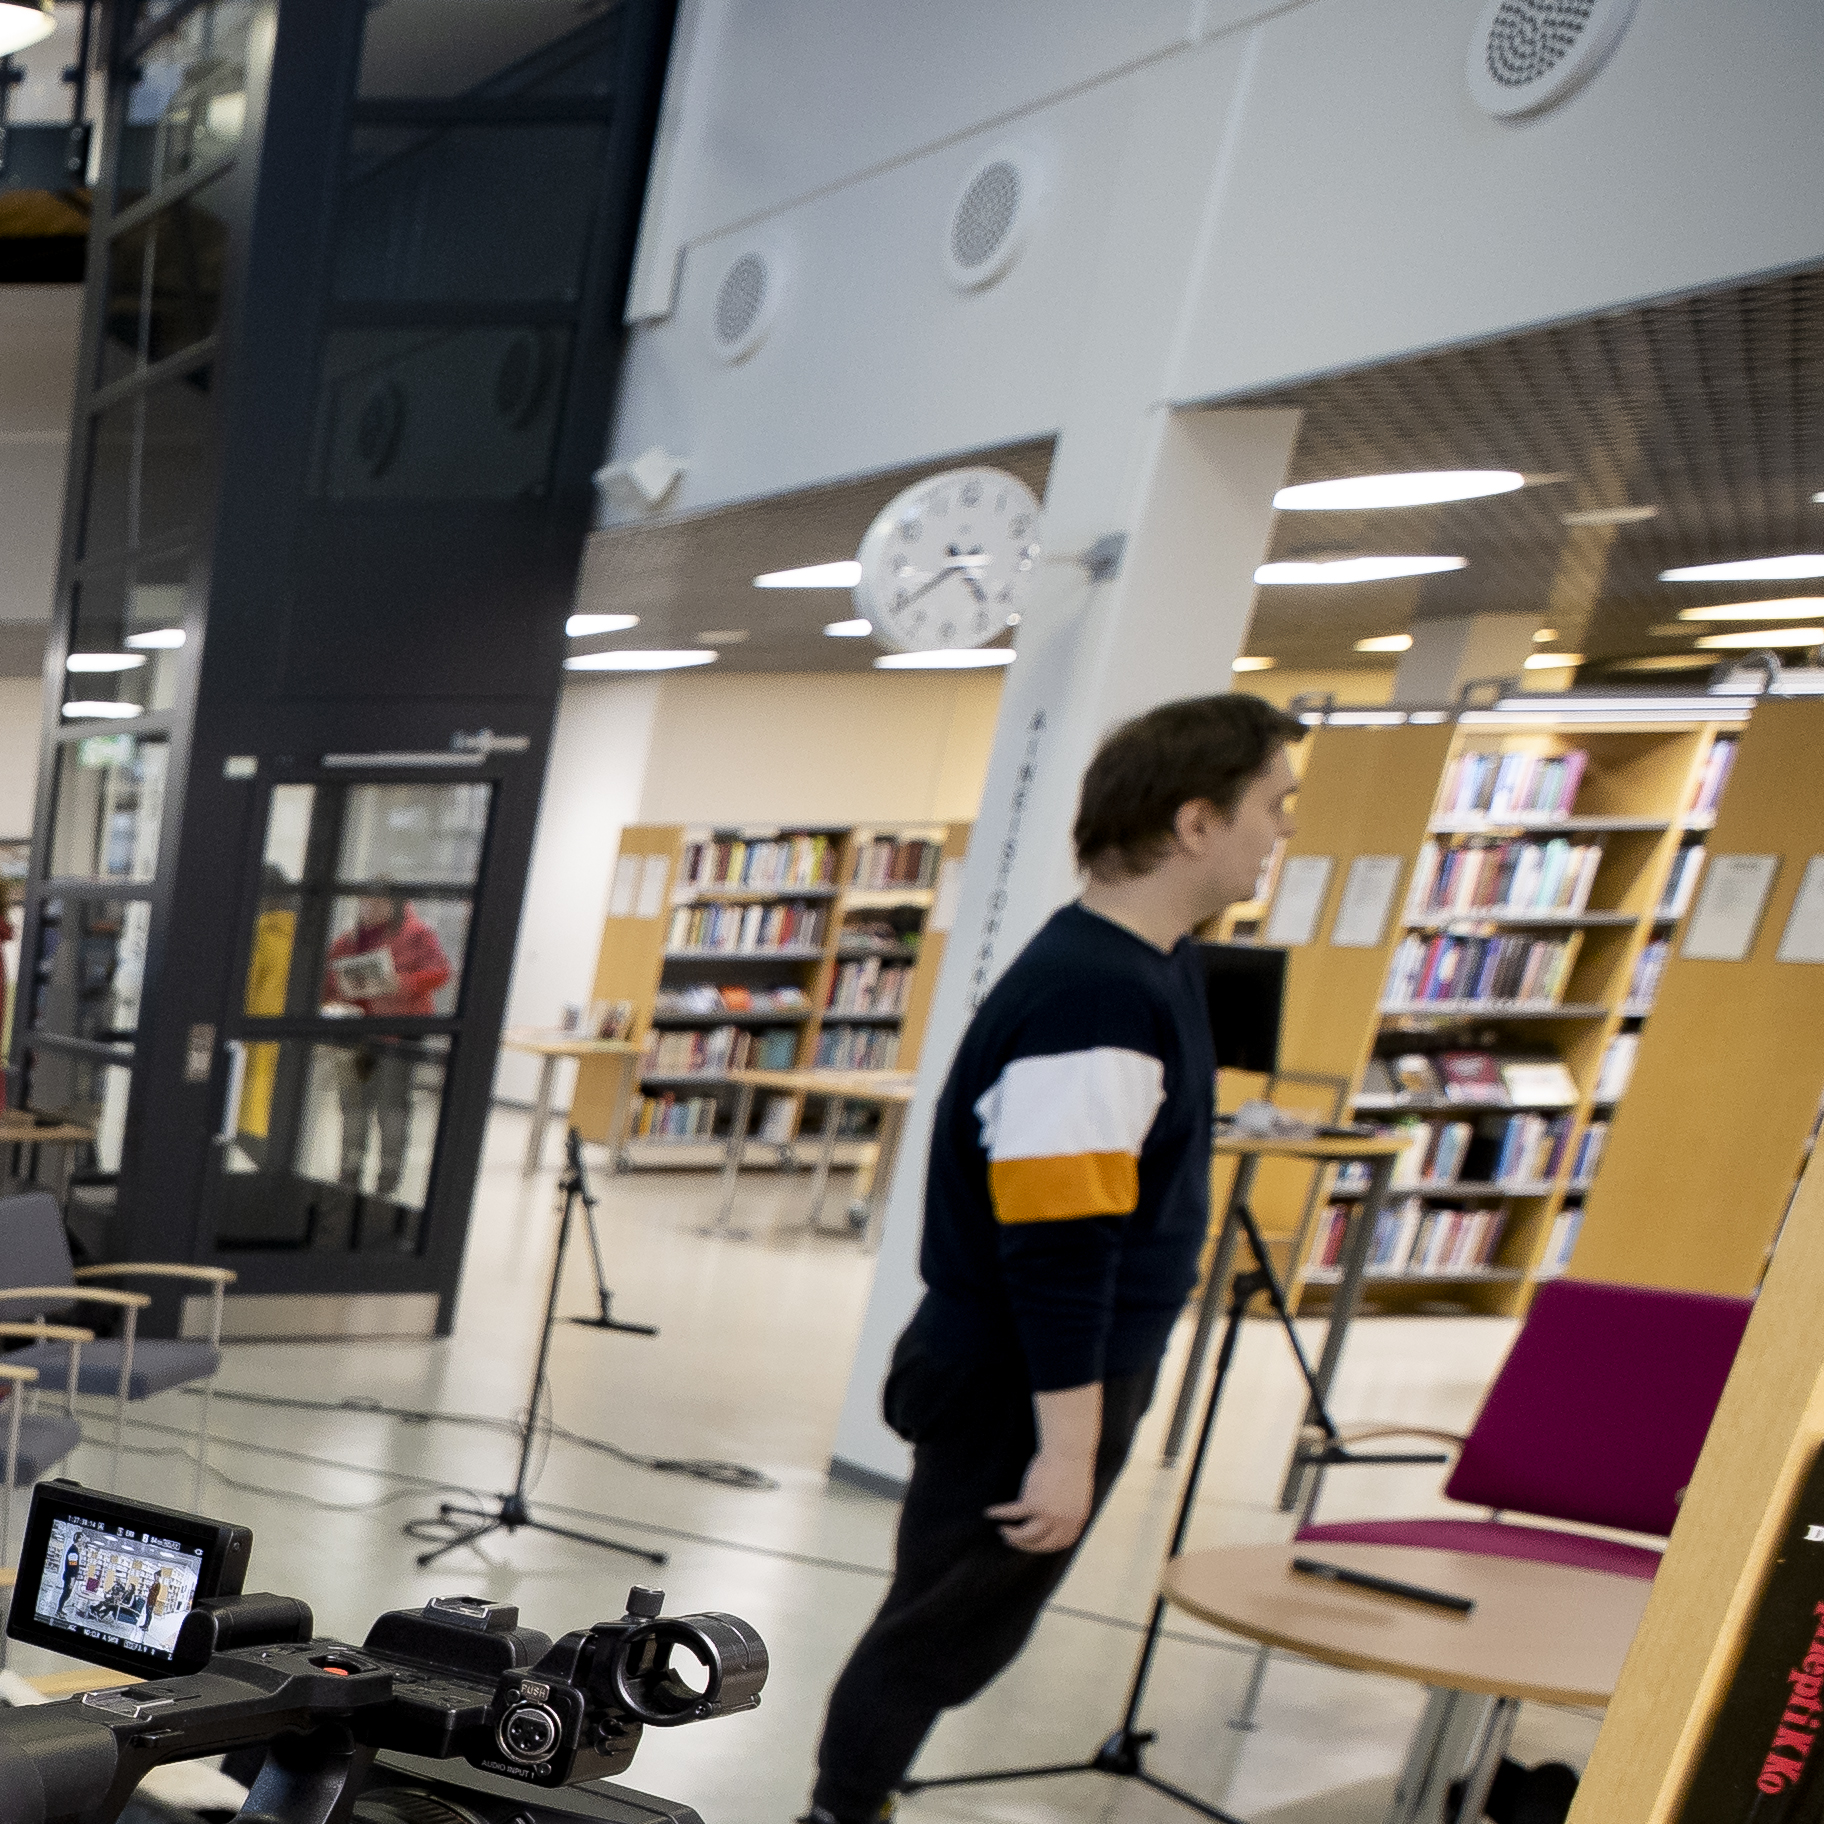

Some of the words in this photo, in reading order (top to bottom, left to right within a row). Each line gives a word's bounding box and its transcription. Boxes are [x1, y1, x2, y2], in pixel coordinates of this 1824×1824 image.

[521, 1683, 546, 1698] PUSH
[481, 1760, 506, 1772] AUDIO
[507, 1766, 530, 1778] INPUT
